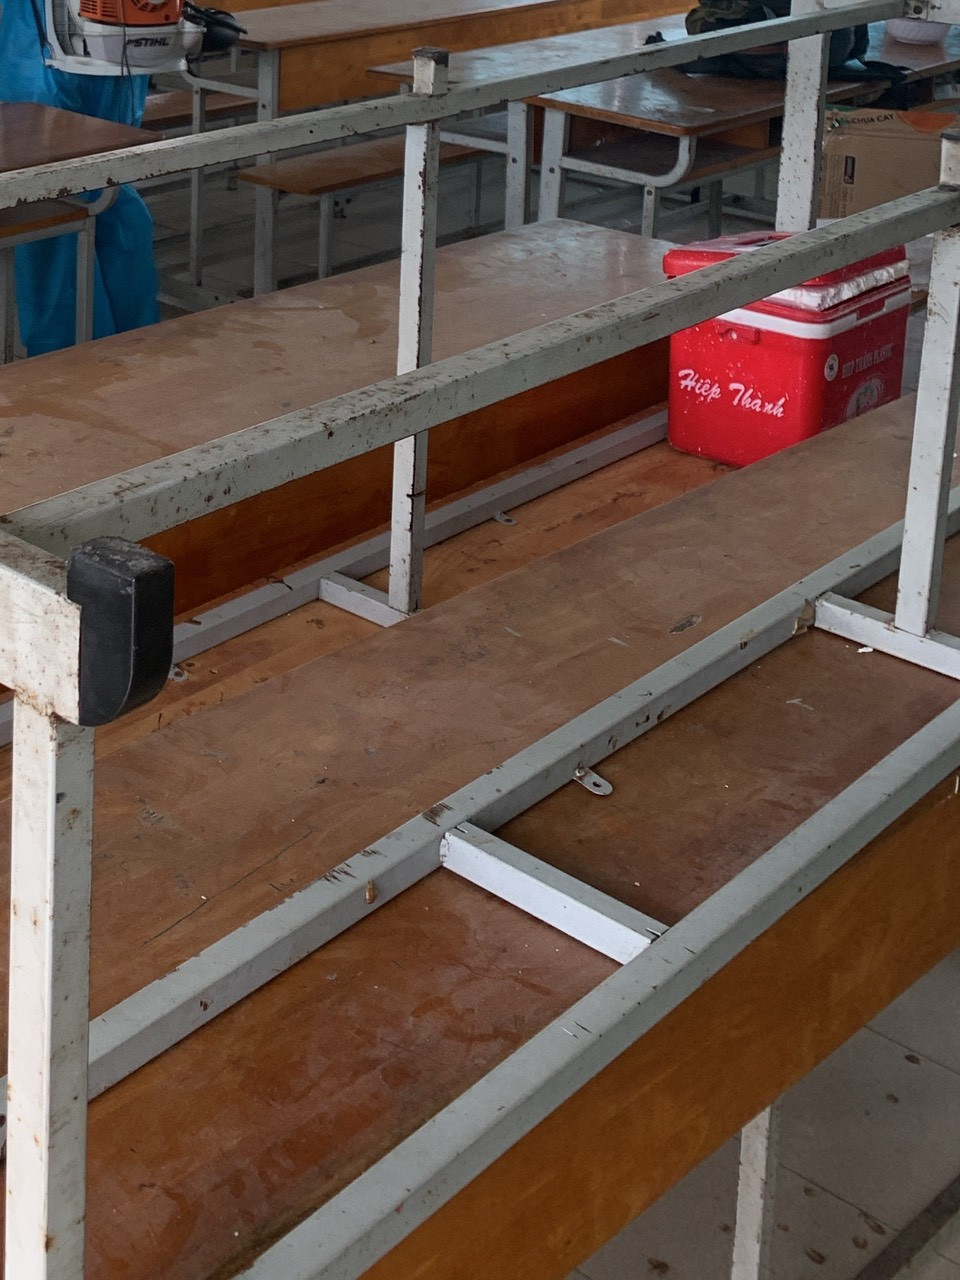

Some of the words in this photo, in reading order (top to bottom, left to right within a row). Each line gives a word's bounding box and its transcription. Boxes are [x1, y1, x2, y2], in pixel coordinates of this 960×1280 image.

[133, 37, 169, 48] STIHL
[678, 368, 722, 402] Hiệp
[729, 382, 785, 418] Thành
